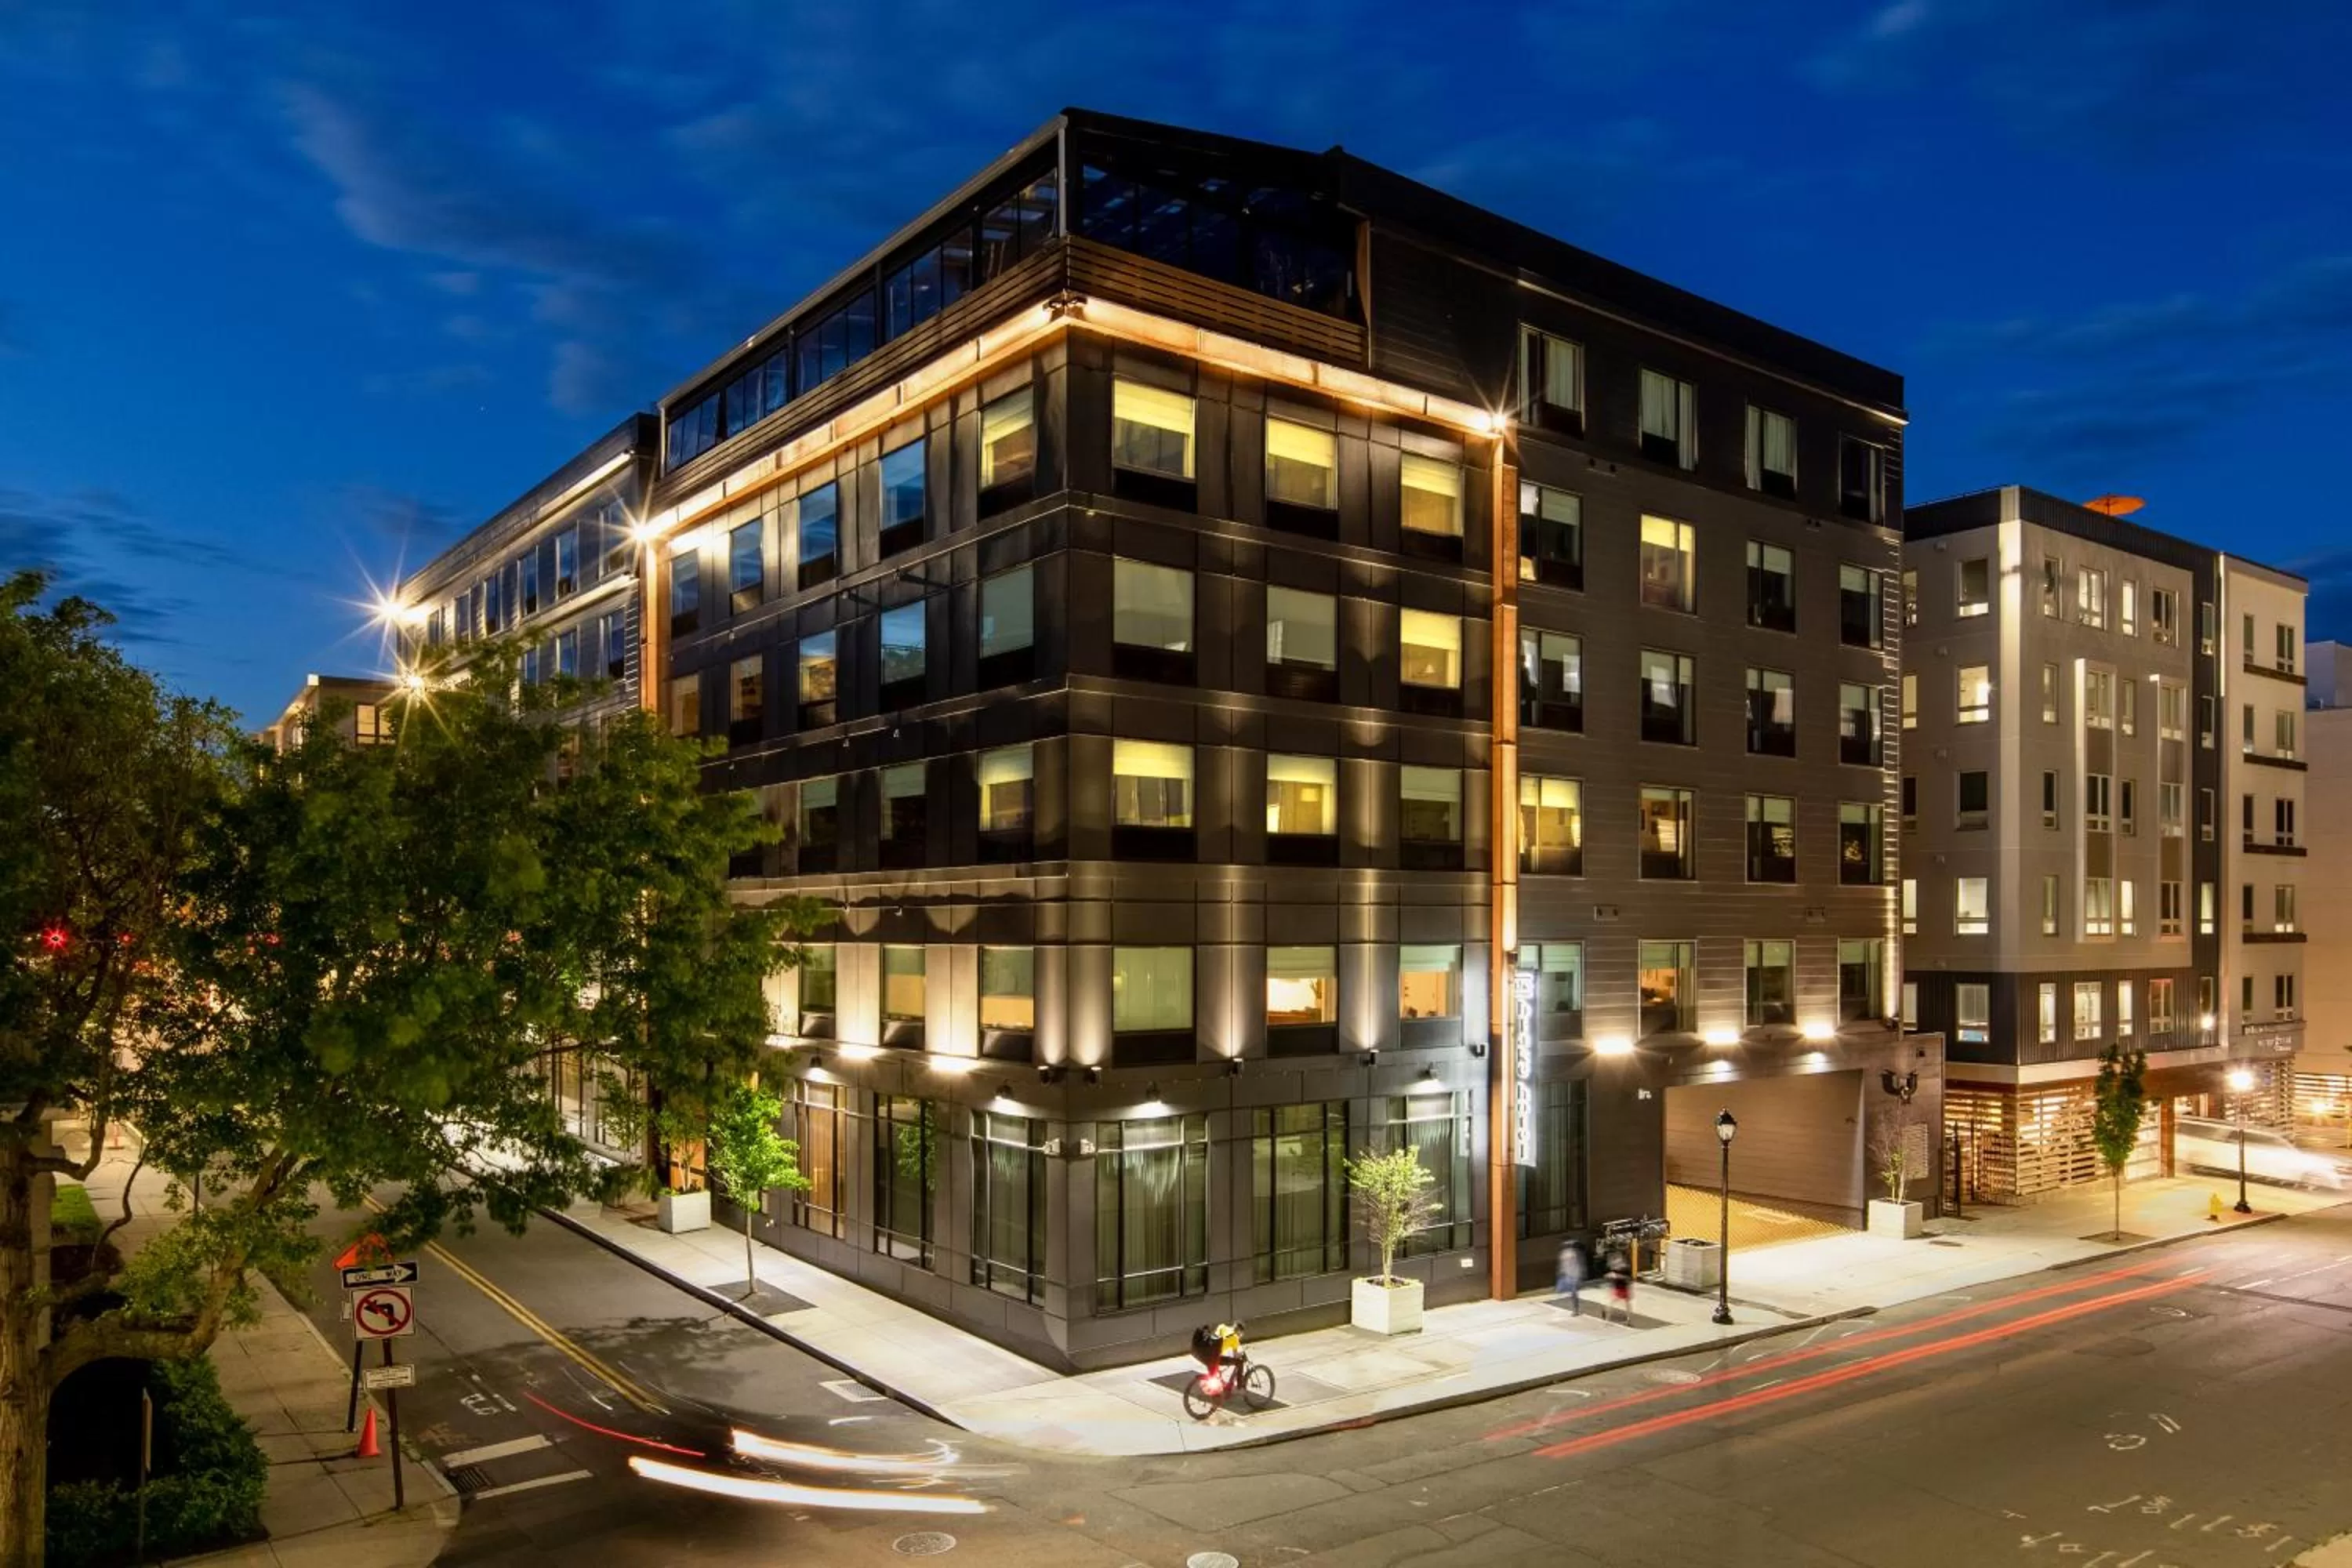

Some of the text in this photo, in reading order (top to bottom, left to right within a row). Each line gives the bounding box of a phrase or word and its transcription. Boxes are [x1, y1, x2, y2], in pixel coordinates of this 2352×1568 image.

[1516, 1083, 1530, 1159] hotel
[354, 1269, 402, 1282] ONE WAY
